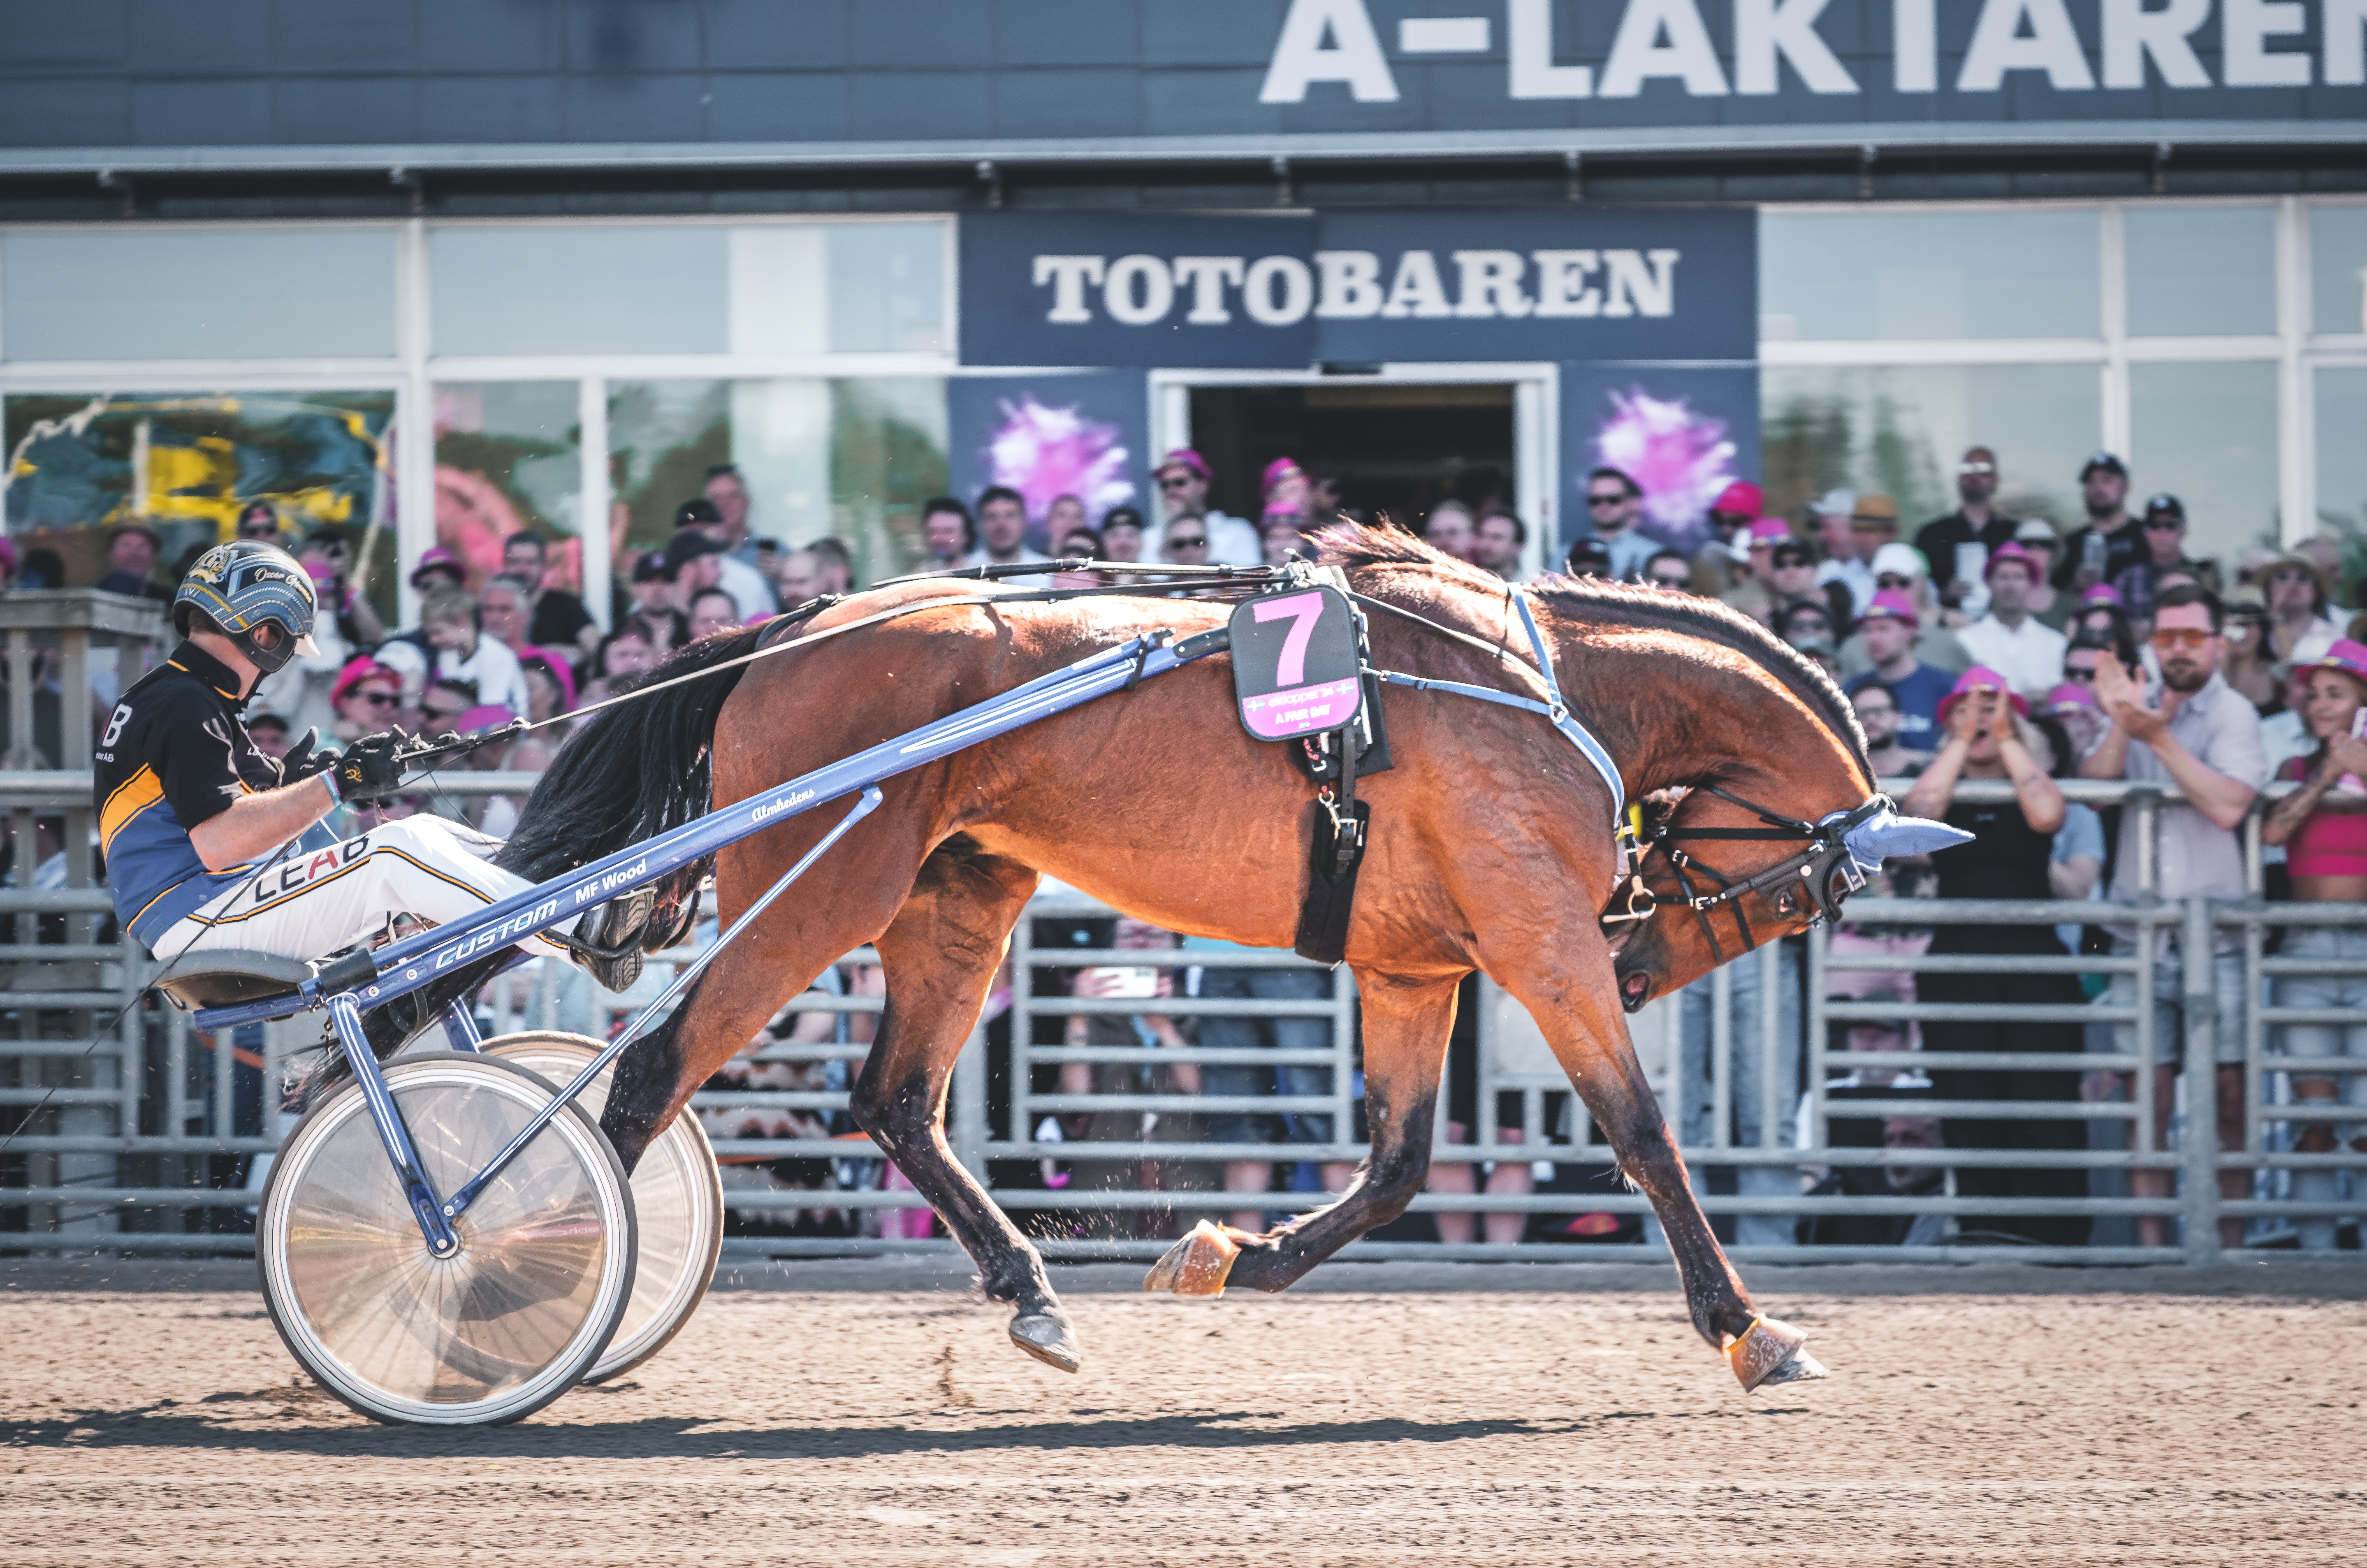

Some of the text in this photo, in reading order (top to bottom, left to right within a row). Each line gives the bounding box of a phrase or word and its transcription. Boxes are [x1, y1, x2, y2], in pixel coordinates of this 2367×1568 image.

[1033, 250, 1680, 326] TOTOBAREN
[1253, 591, 1324, 687] 7
[1276, 713, 1284, 724] A
[1310, 703, 1331, 718] DAY
[752, 789, 815, 822] Almhedens
[436, 858, 647, 969] CUSTOM MF Wood
